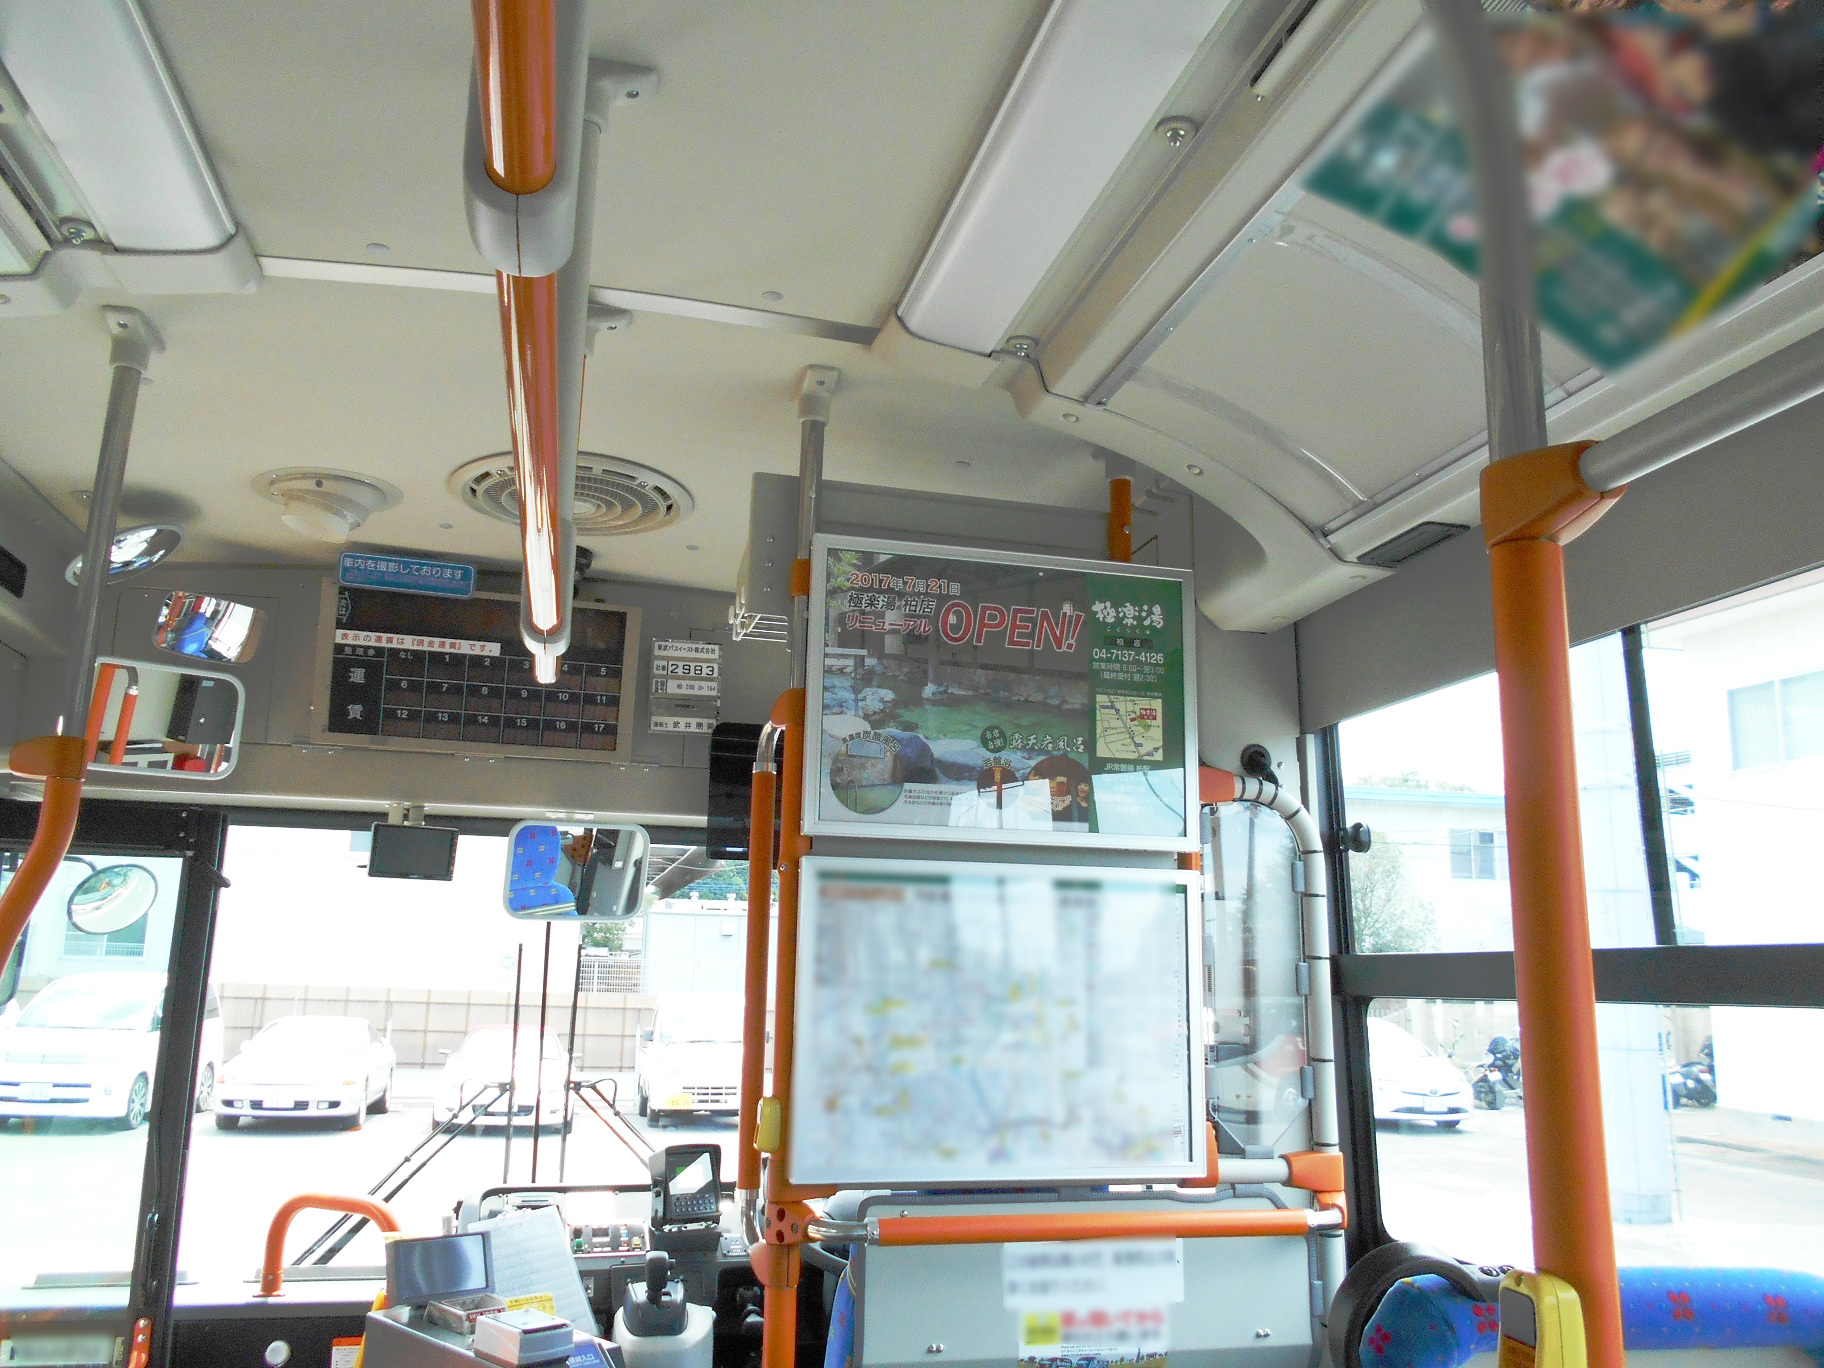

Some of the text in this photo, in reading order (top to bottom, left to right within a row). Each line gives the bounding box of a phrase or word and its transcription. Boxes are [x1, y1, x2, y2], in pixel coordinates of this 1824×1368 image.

[343, 557, 464, 580] 車内を撮影しております
[849, 572, 960, 595] 2017年7月21日
[848, 591, 936, 615] 極楽湯 柏店
[1091, 600, 1164, 628] 極楽湯
[846, 613, 932, 635] リニューアル
[939, 600, 1084, 652] OPEN!
[657, 644, 716, 655] 東武バスイースト株式会社
[1092, 648, 1164, 664] 04-7137-4126
[445, 654, 450, 662] 1
[484, 658, 491, 666] 2
[523, 661, 530, 669] 3
[562, 664, 568, 672] 4
[600, 667, 607, 675] 5
[670, 663, 715, 676] 2983
[401, 681, 606, 704] 6 7 8 9 10 11
[397, 710, 605, 732] 12 13 14 15 16 17
[1009, 732, 1085, 753] 露天岩風呂
